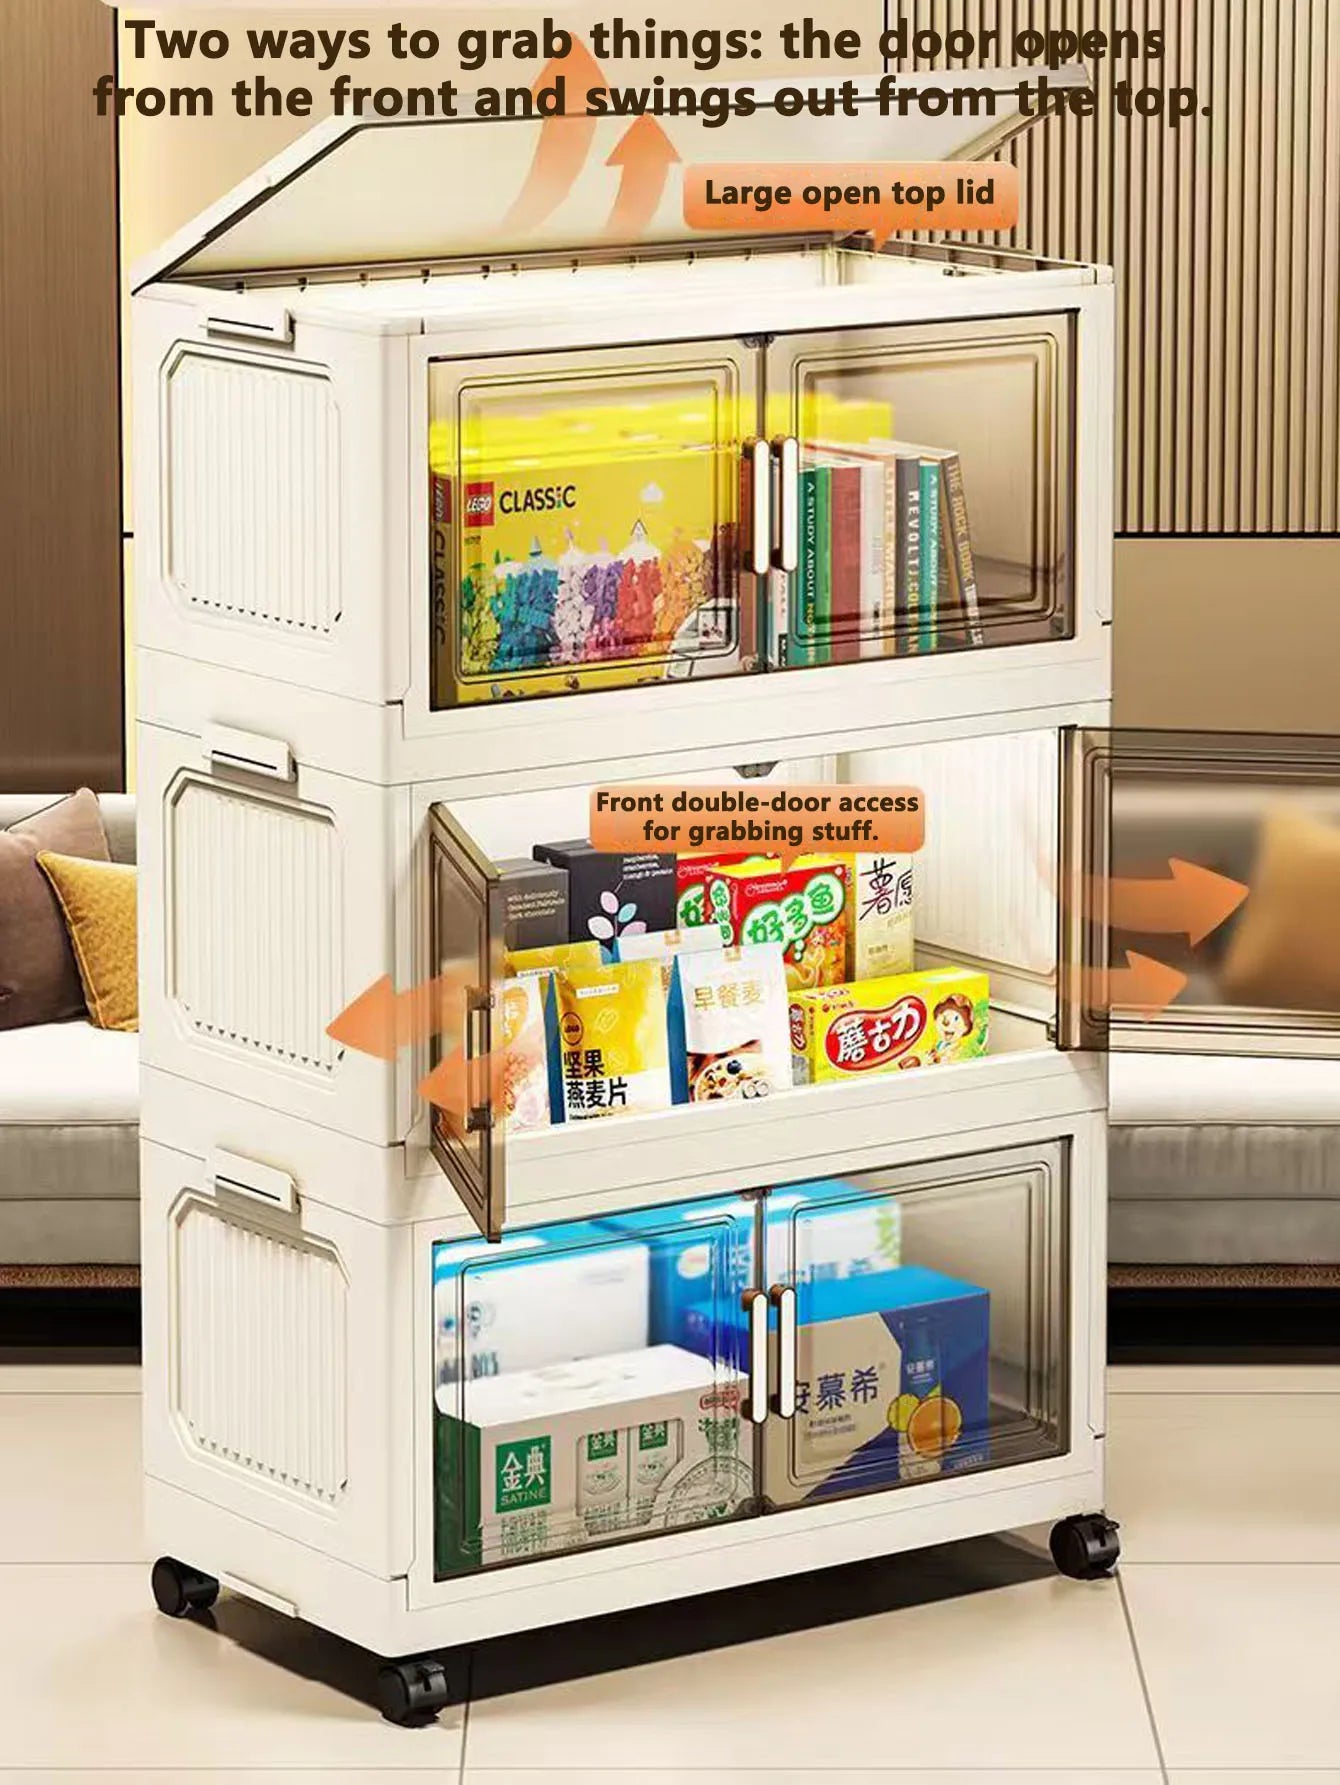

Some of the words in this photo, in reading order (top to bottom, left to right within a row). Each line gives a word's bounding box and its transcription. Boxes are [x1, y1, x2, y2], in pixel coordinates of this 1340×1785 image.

[466, 495, 492, 513] LEGO
[806, 497, 816, 545] STUDY
[806, 546, 816, 598] ABOUT
[748, 881, 835, 944] 好多鱼
[836, 1003, 921, 1063] 蘑古力
[564, 1049, 605, 1079] 坚果
[566, 1077, 628, 1110] 燕麦片
[500, 1445, 547, 1494] 金典
[500, 1487, 548, 1507] SATINE
